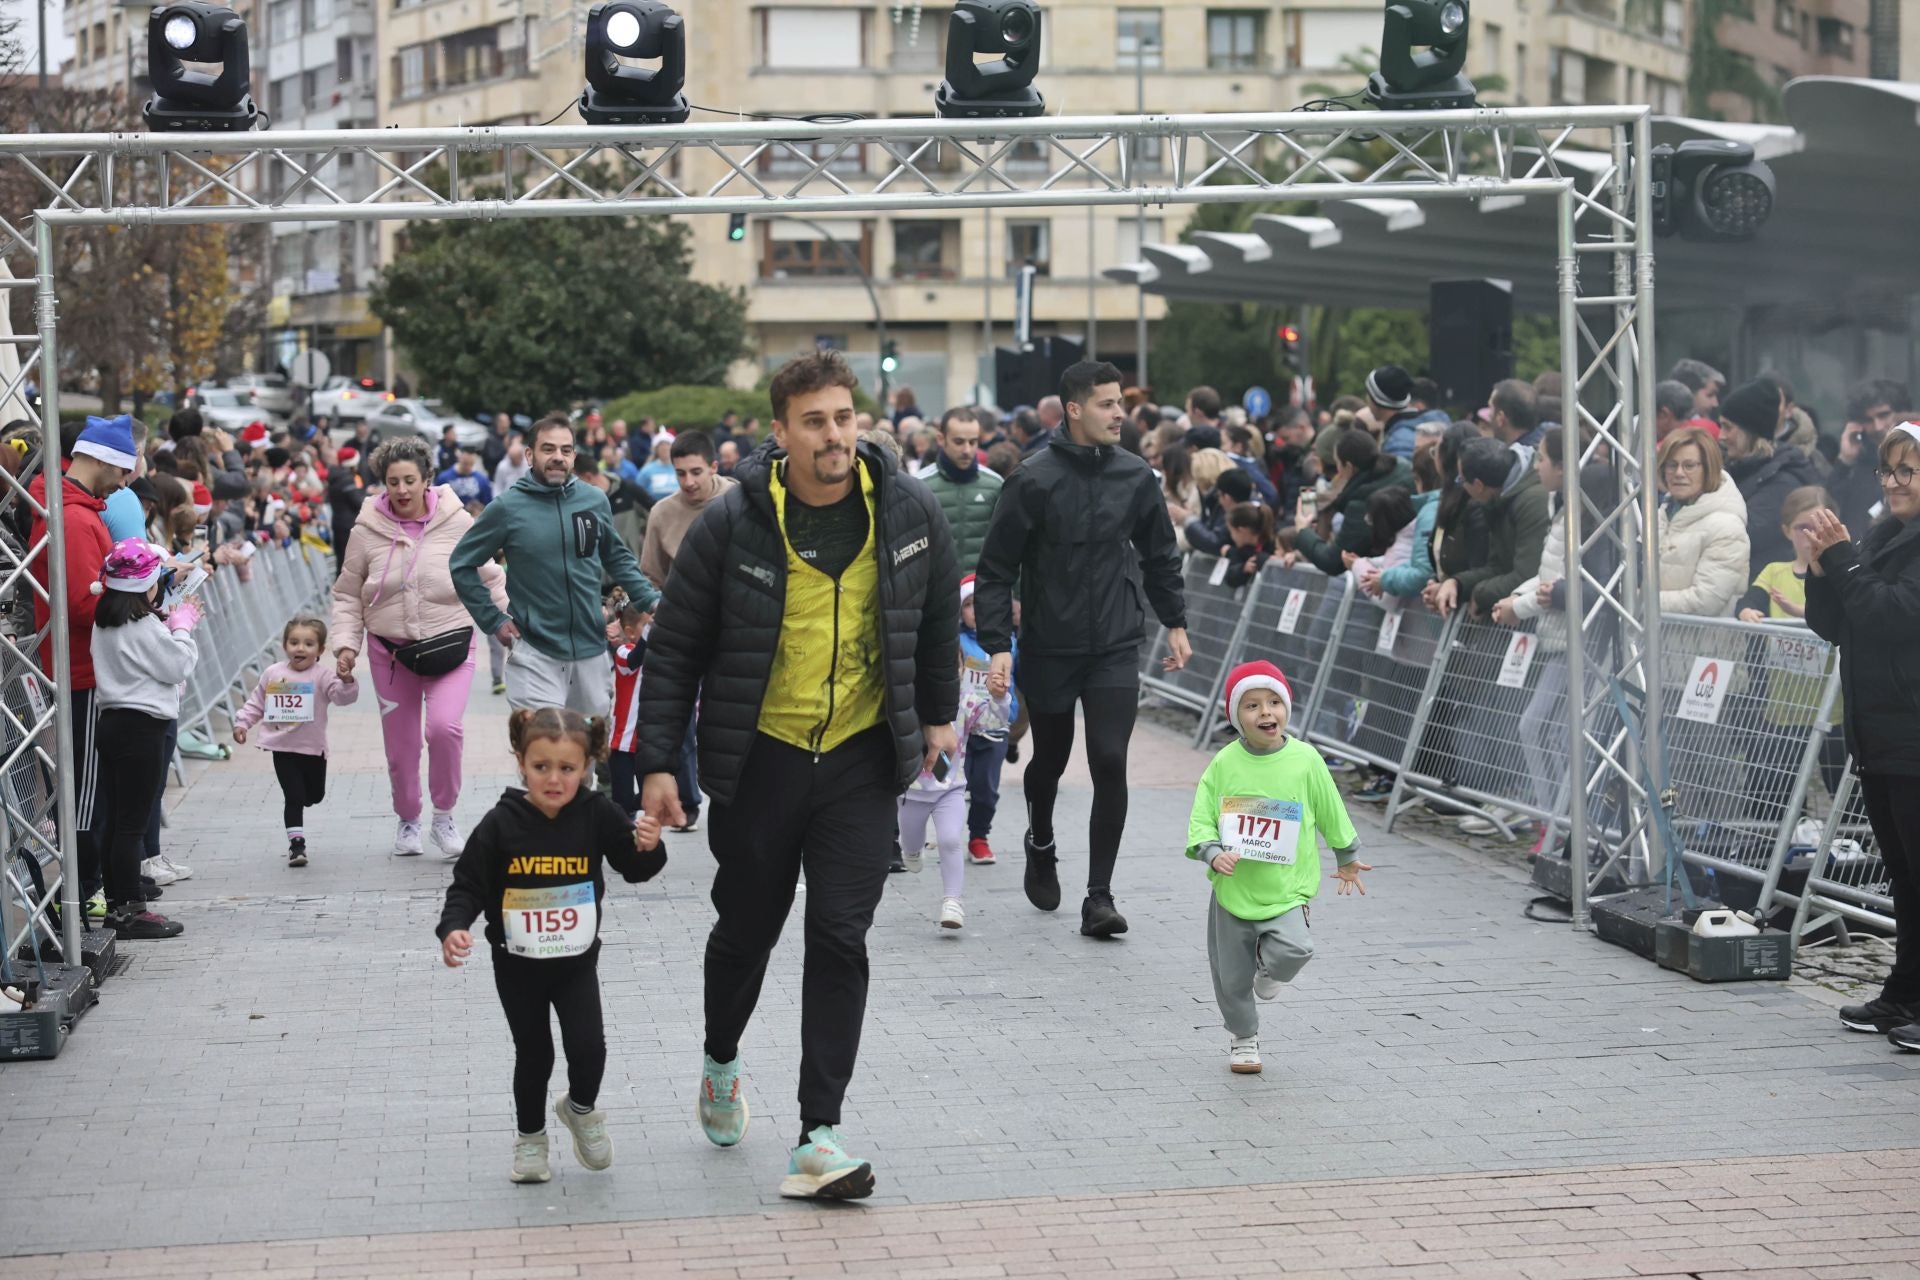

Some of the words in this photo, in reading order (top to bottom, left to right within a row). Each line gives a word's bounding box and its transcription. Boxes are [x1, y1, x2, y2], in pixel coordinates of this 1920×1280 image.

[273, 695, 304, 708] 1132
[1237, 814, 1282, 841] 1171
[1241, 837, 1272, 849] MARCO
[1243, 848, 1287, 862] PDMSiero
[521, 908, 579, 934] 1159
